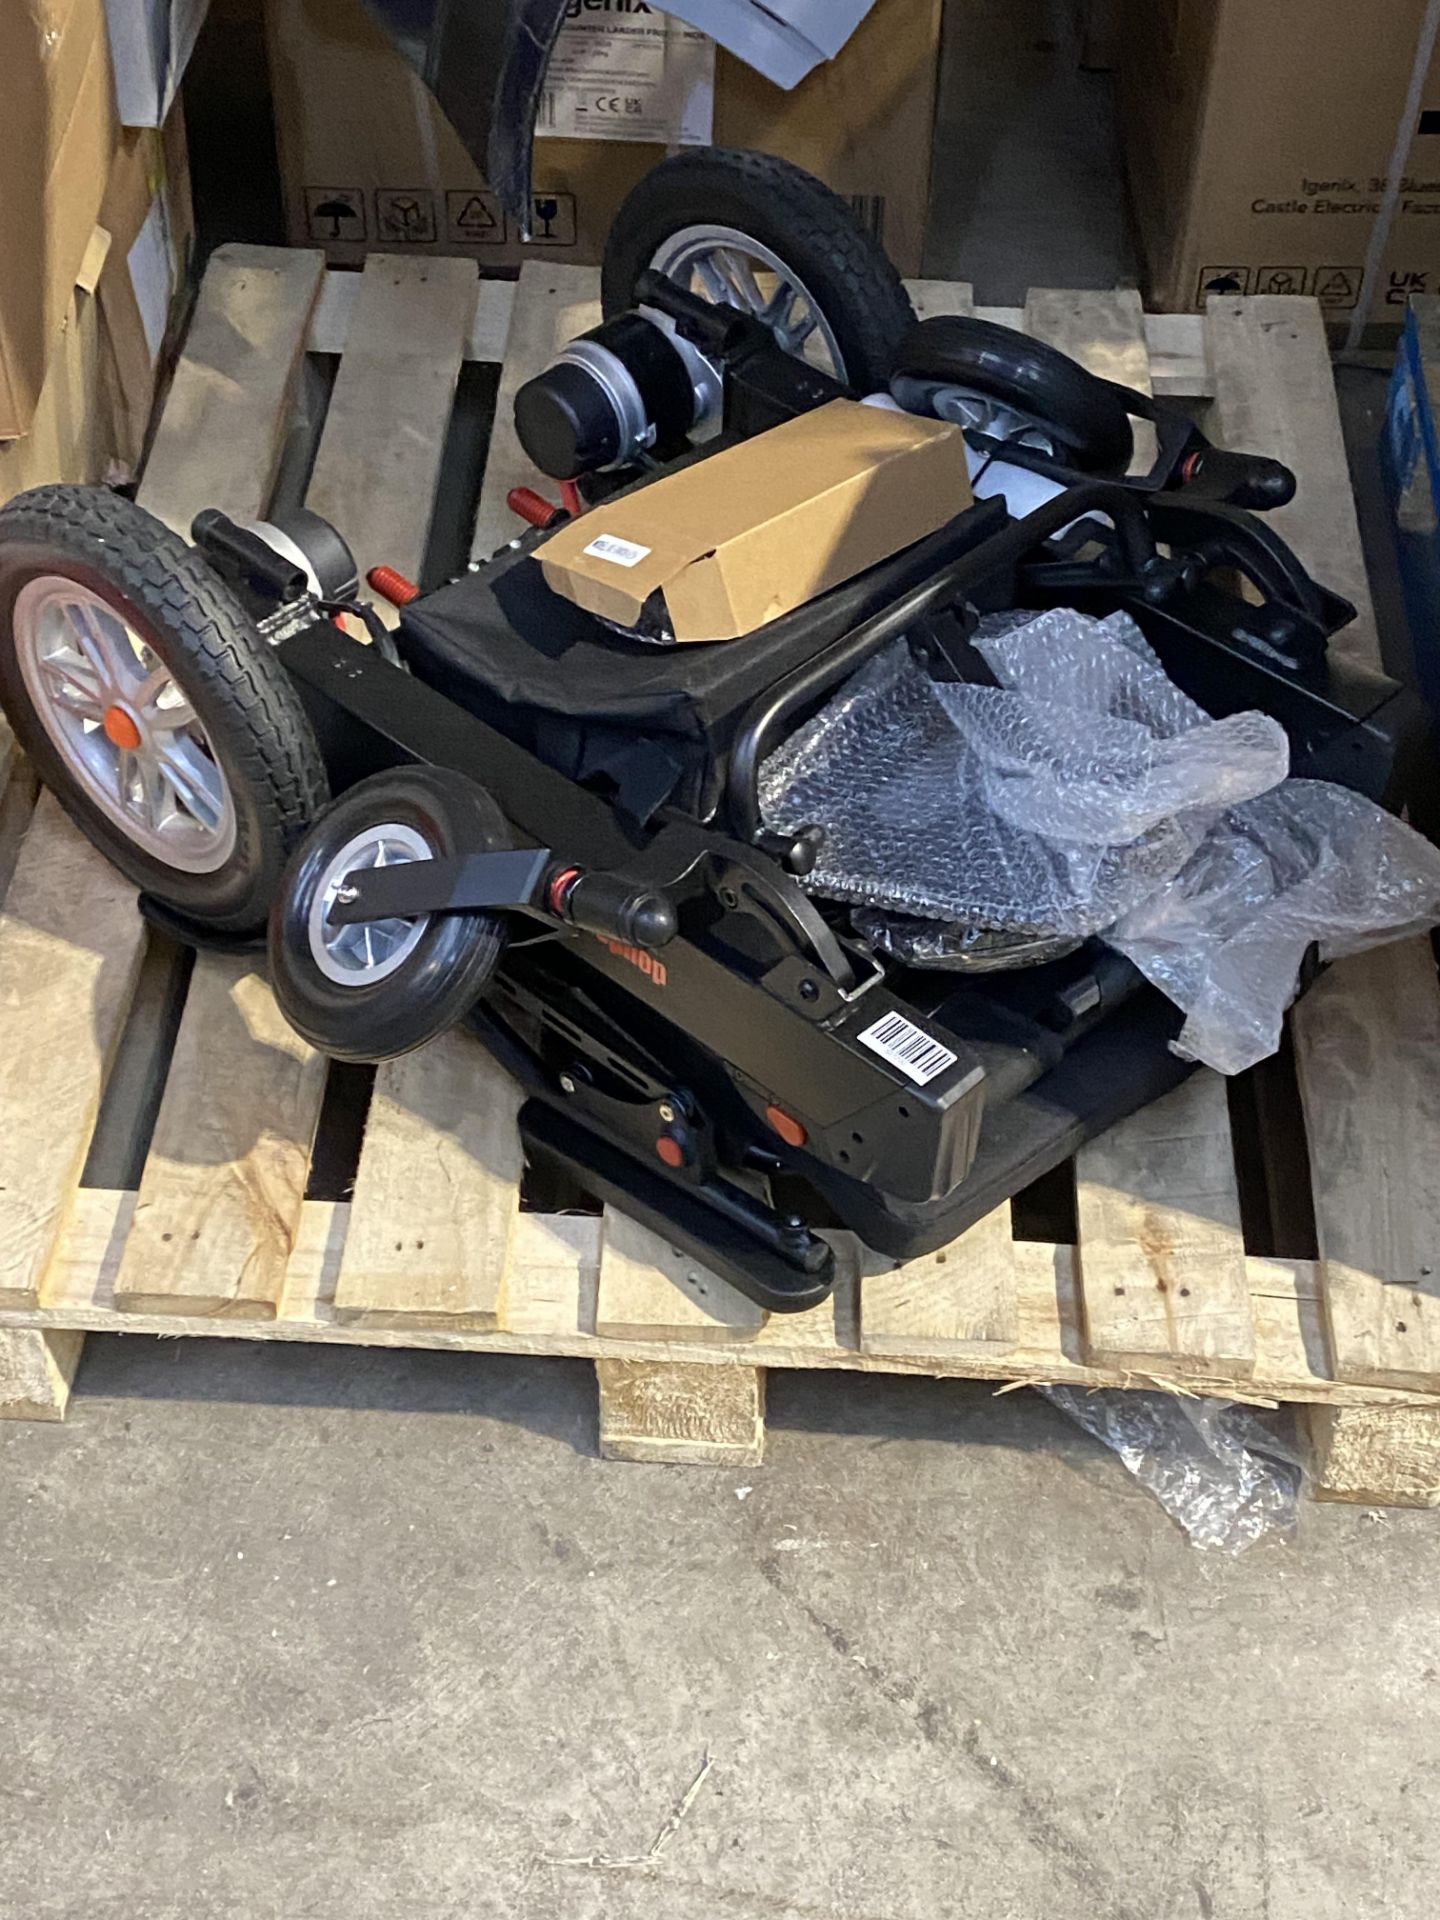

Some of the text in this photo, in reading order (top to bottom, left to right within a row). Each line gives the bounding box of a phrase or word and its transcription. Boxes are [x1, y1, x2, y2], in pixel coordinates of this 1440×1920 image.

[562, 0, 652, 18] genix
[1252, 199, 1308, 214] Castle
[1313, 200, 1381, 214] Electric
[1389, 271, 1430, 287] UK
[1386, 287, 1425, 304] C
